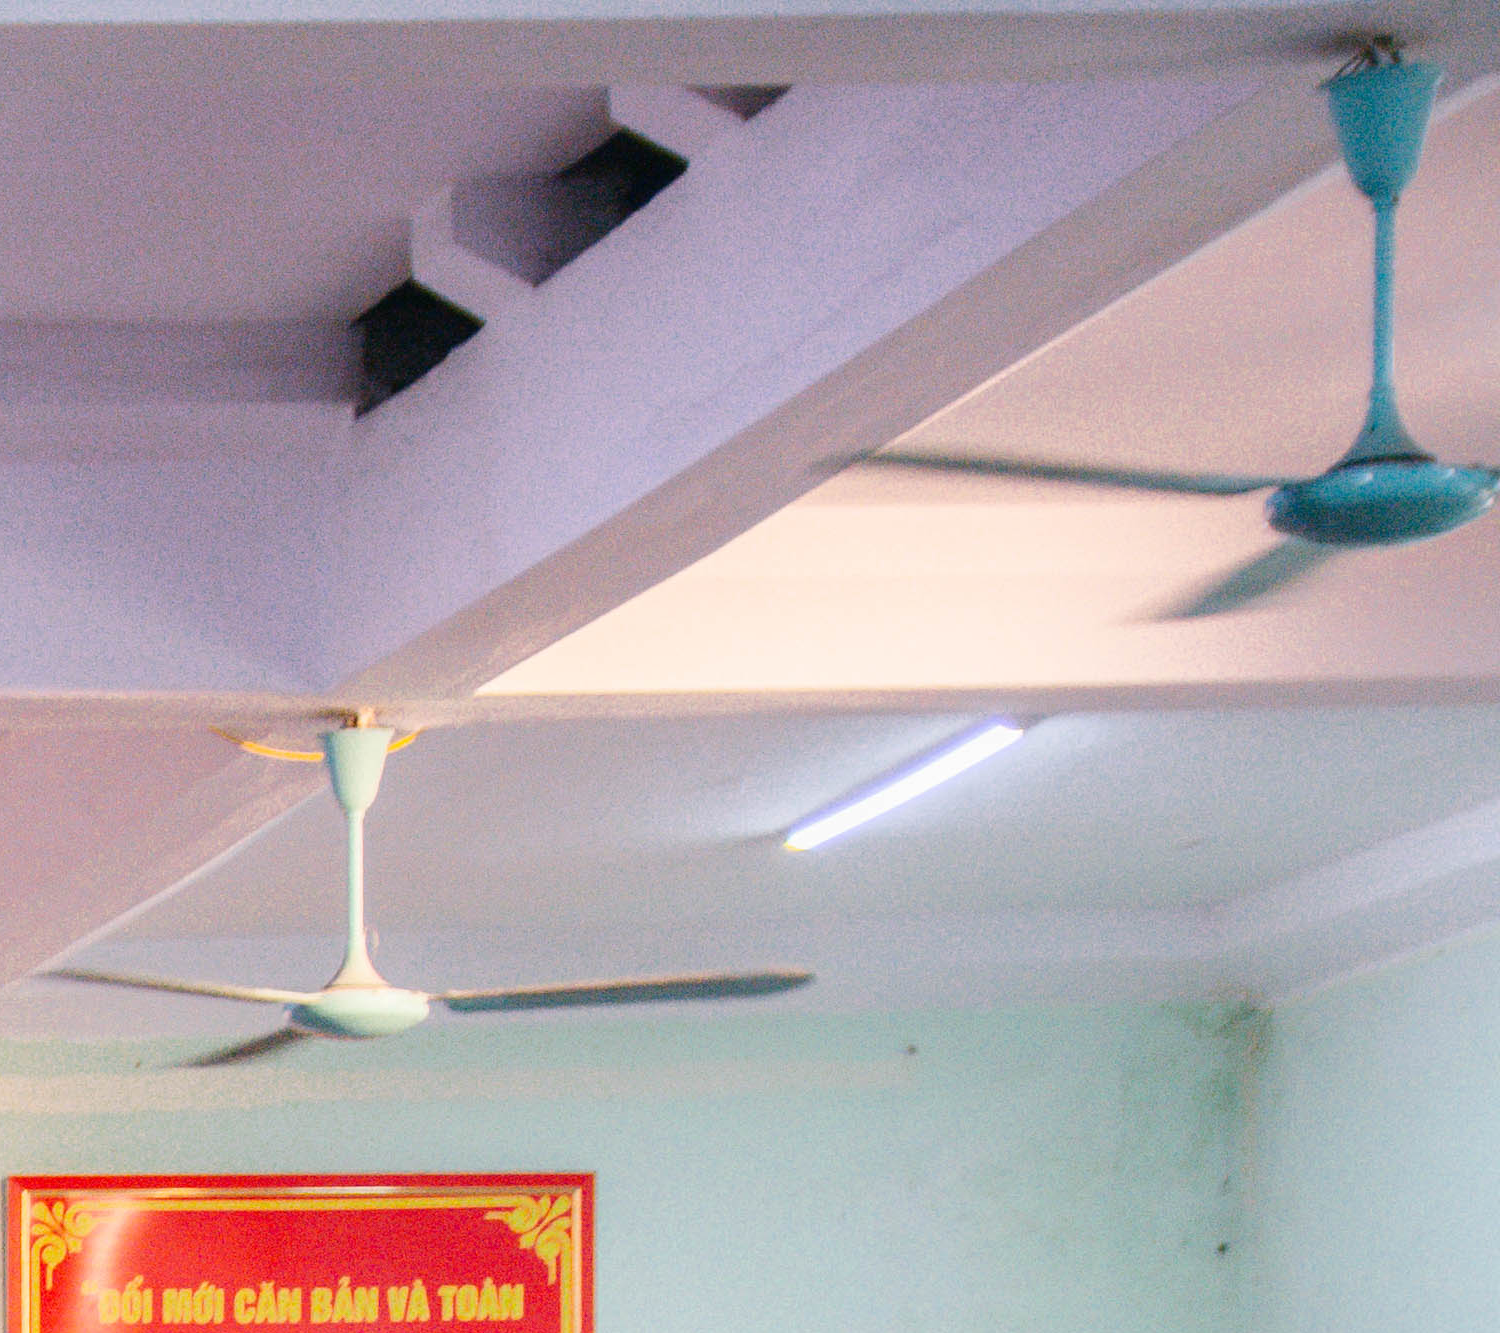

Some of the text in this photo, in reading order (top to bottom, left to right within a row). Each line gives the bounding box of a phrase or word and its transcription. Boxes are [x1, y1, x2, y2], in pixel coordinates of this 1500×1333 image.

[163, 1283, 224, 1324] MỚI
[234, 1283, 301, 1323] CĂN
[311, 1277, 378, 1322] BẢN
[388, 1281, 429, 1321] VÀ
[439, 1280, 524, 1321] TOÀN
